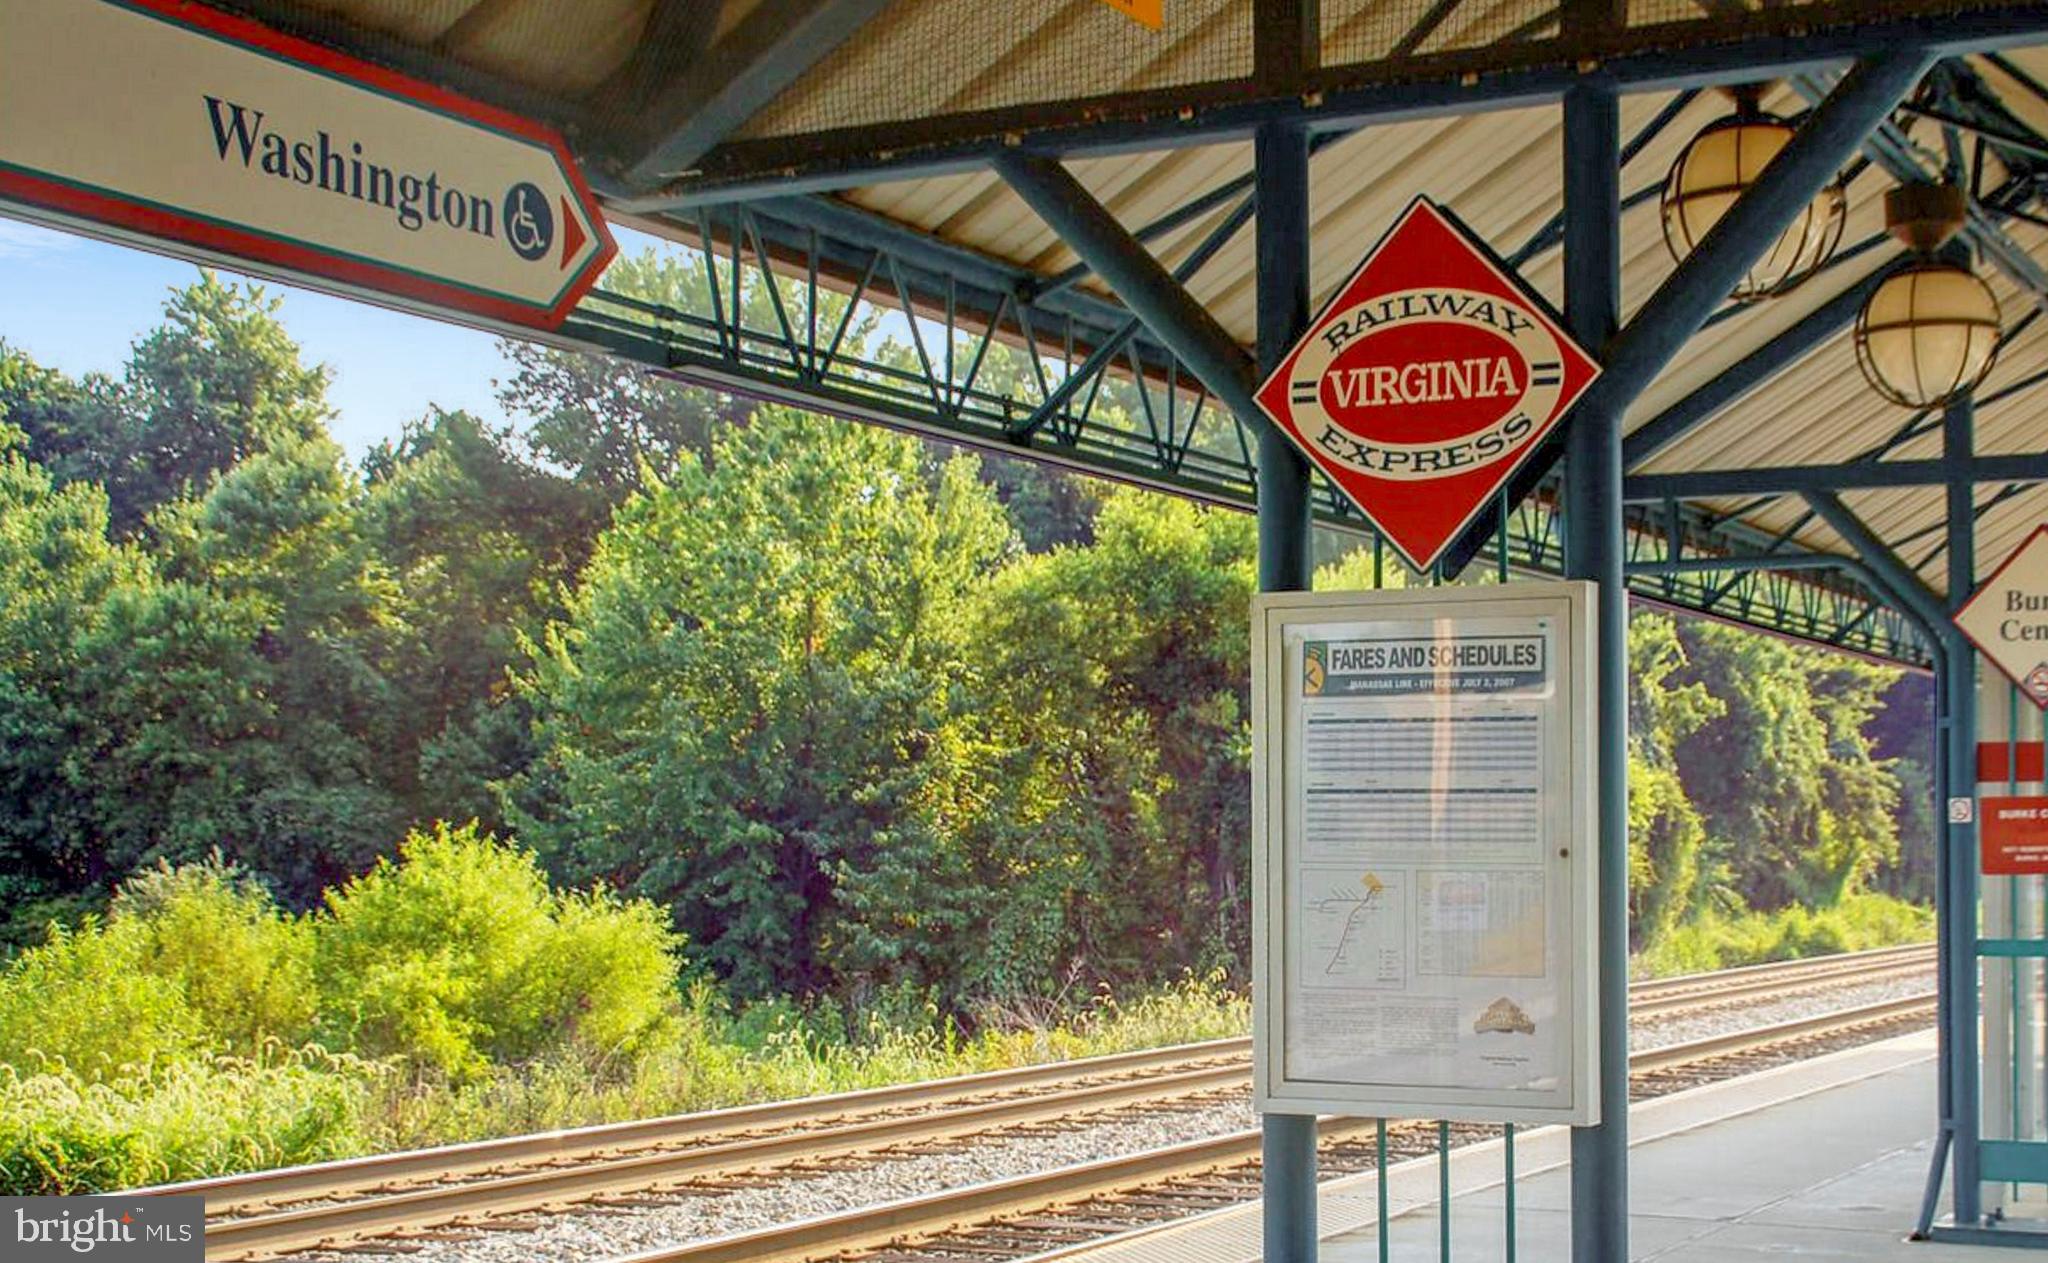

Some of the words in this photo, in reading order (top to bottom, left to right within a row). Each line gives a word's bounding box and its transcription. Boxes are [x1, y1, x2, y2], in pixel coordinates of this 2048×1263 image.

[202, 94, 496, 239] Washington
[1321, 293, 1535, 353] RAILWAY
[1327, 355, 1520, 409] VIRGINIA
[1316, 412, 1533, 473] EXPRESS
[1331, 648, 1385, 670] FARES
[1386, 646, 1425, 668] AND
[1428, 644, 1537, 668] SCHEDULES
